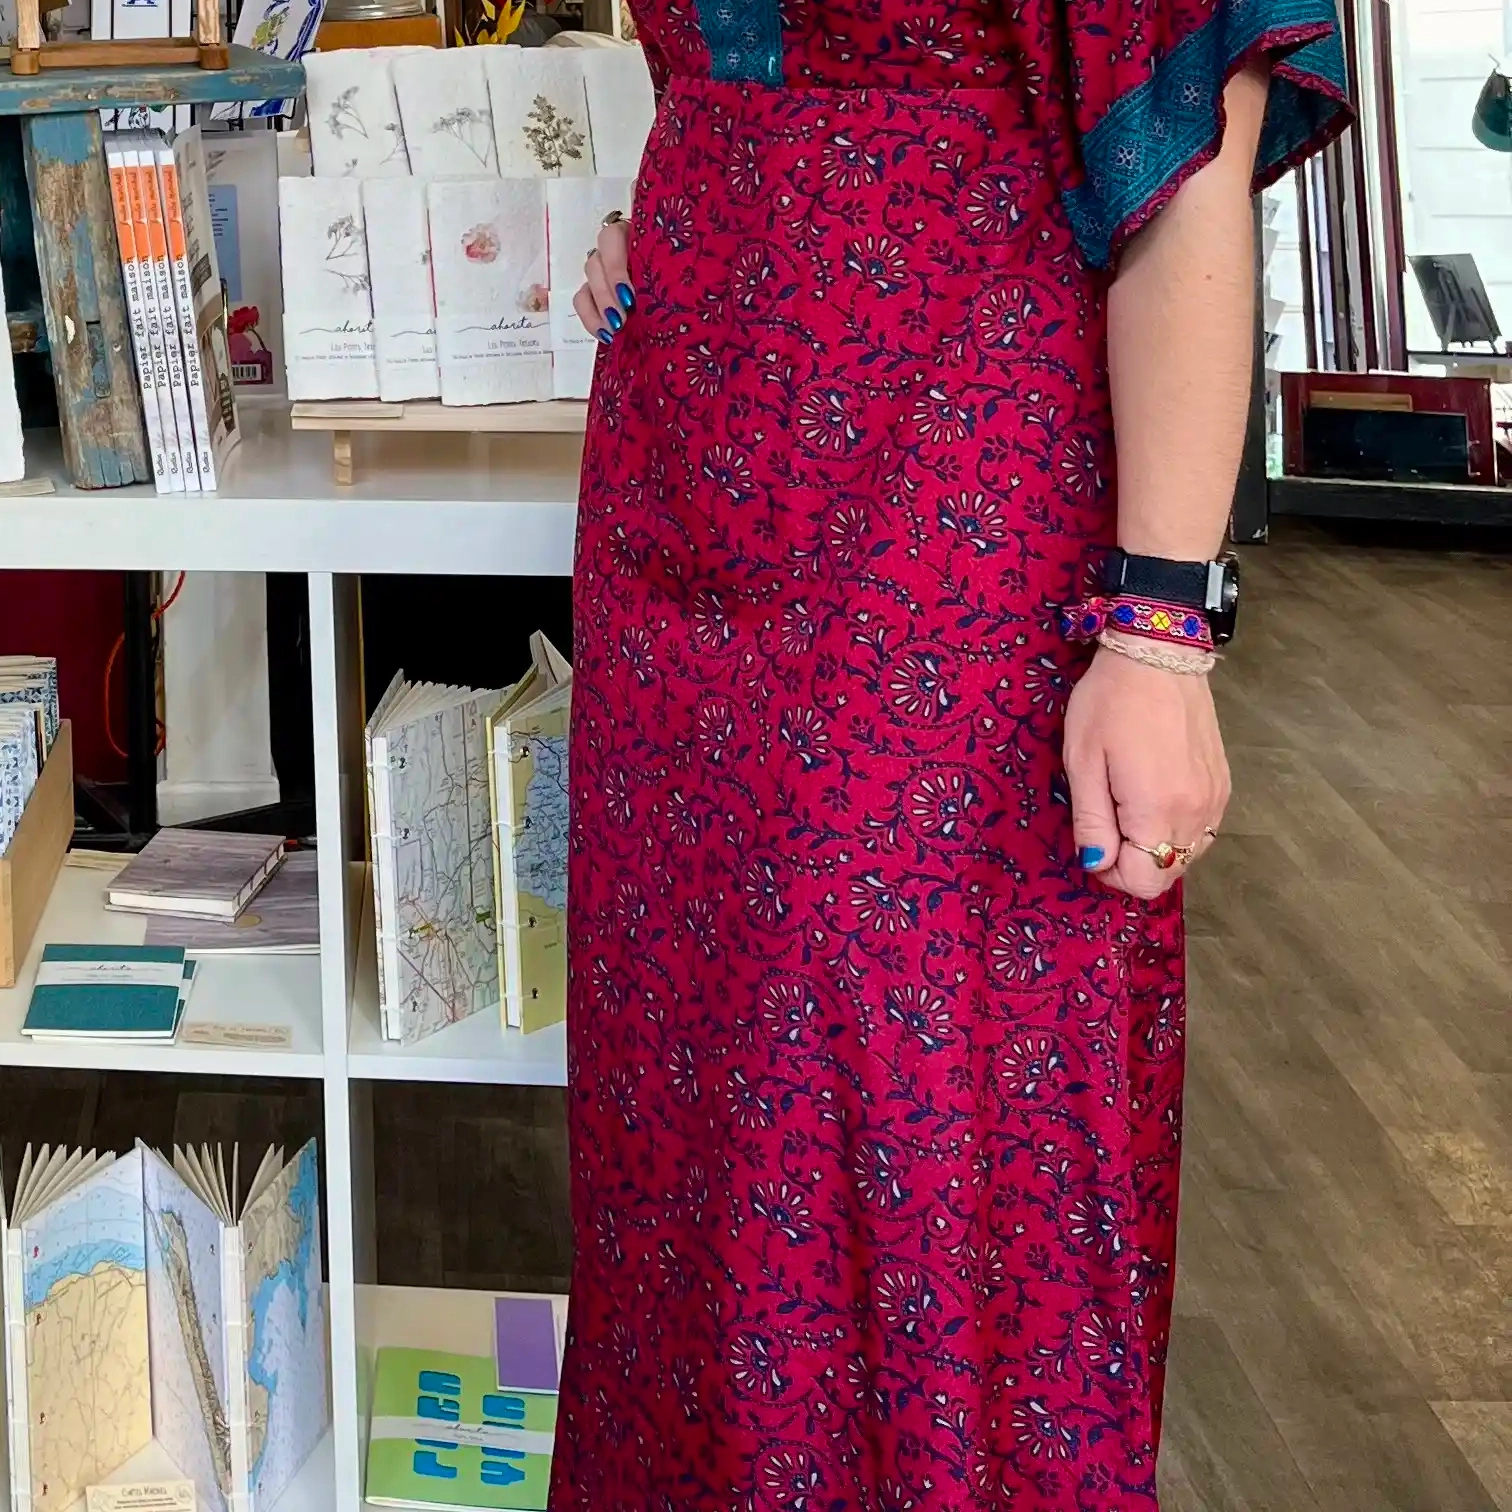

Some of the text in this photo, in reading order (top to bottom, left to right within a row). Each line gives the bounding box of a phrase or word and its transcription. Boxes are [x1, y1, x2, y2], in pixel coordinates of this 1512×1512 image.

[127, 255, 152, 389] Papier fait maison
[142, 255, 166, 388] Papier fait maison
[157, 254, 182, 387] Papier fait maison
[175, 254, 200, 387] Papier fait maison
